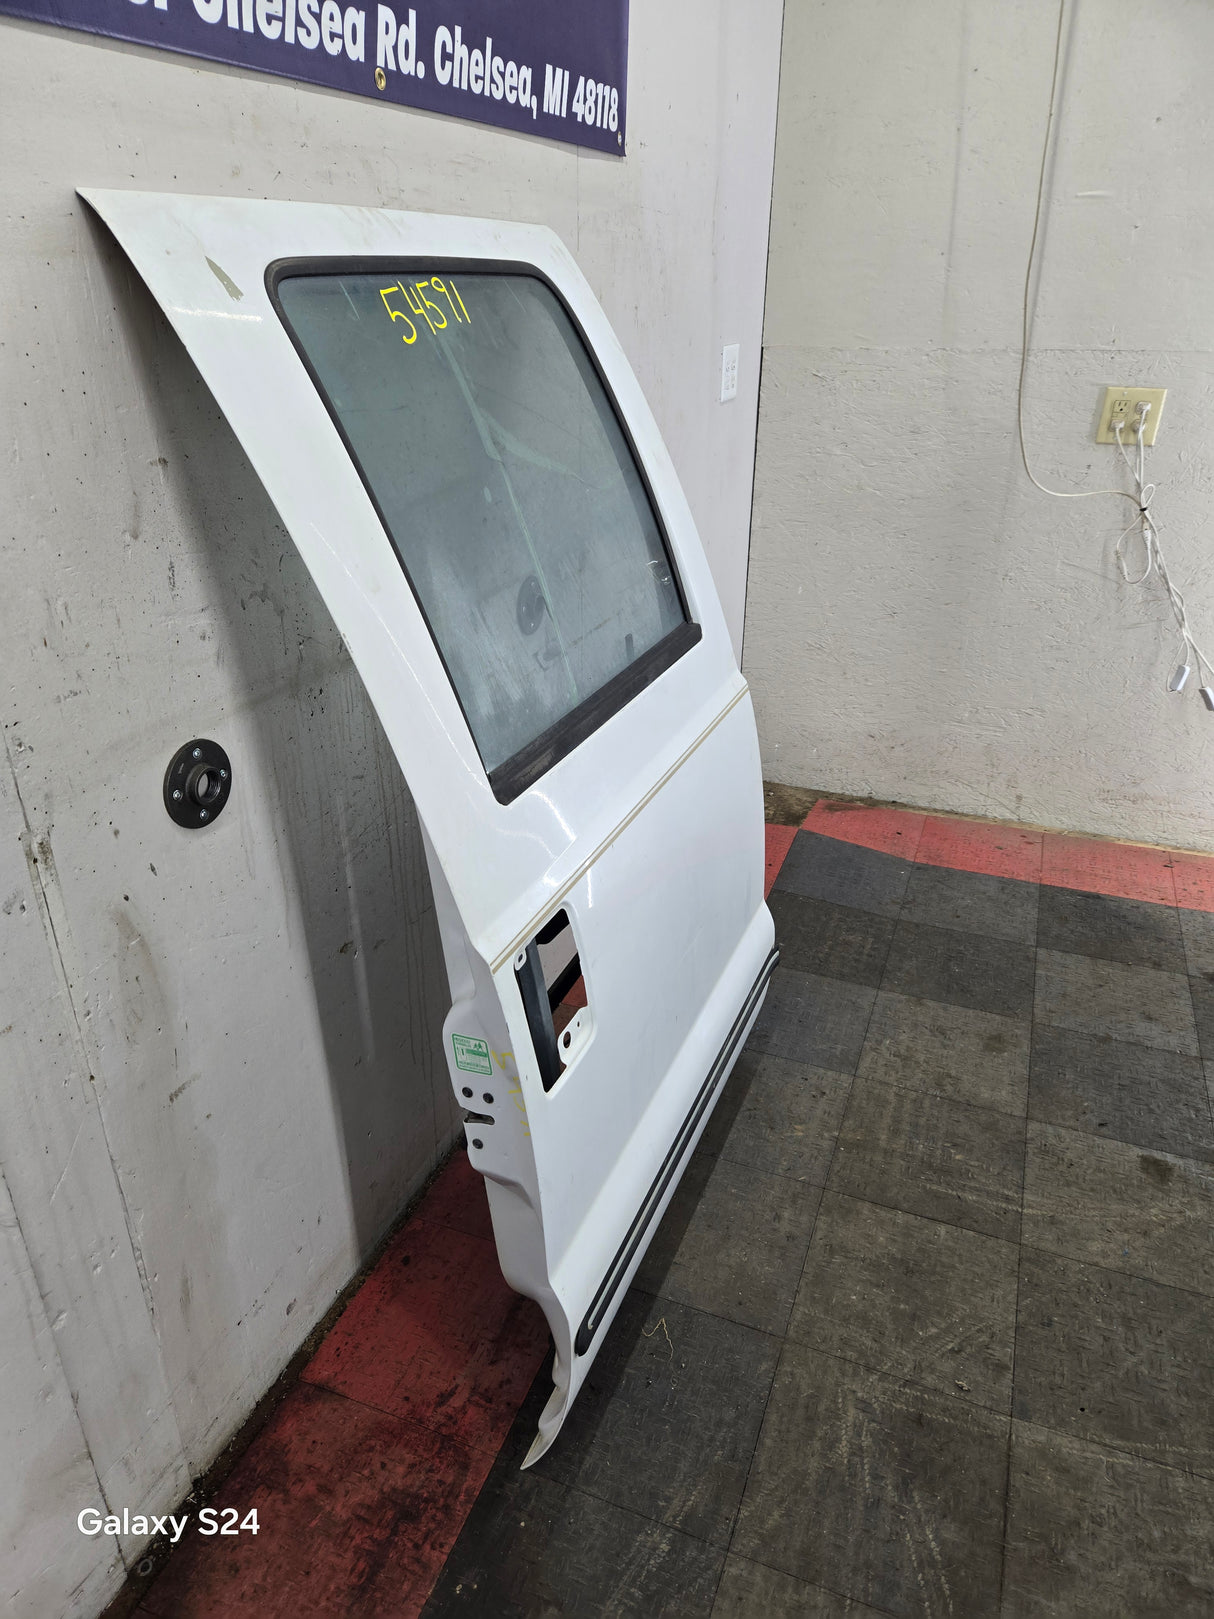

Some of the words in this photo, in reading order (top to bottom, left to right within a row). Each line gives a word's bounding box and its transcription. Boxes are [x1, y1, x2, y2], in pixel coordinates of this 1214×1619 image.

[376, 3, 426, 79] Rd.
[434, 25, 538, 120] Chelsea,
[543, 63, 570, 119] MI
[572, 75, 619, 133] 48118
[379, 276, 471, 345] 54591
